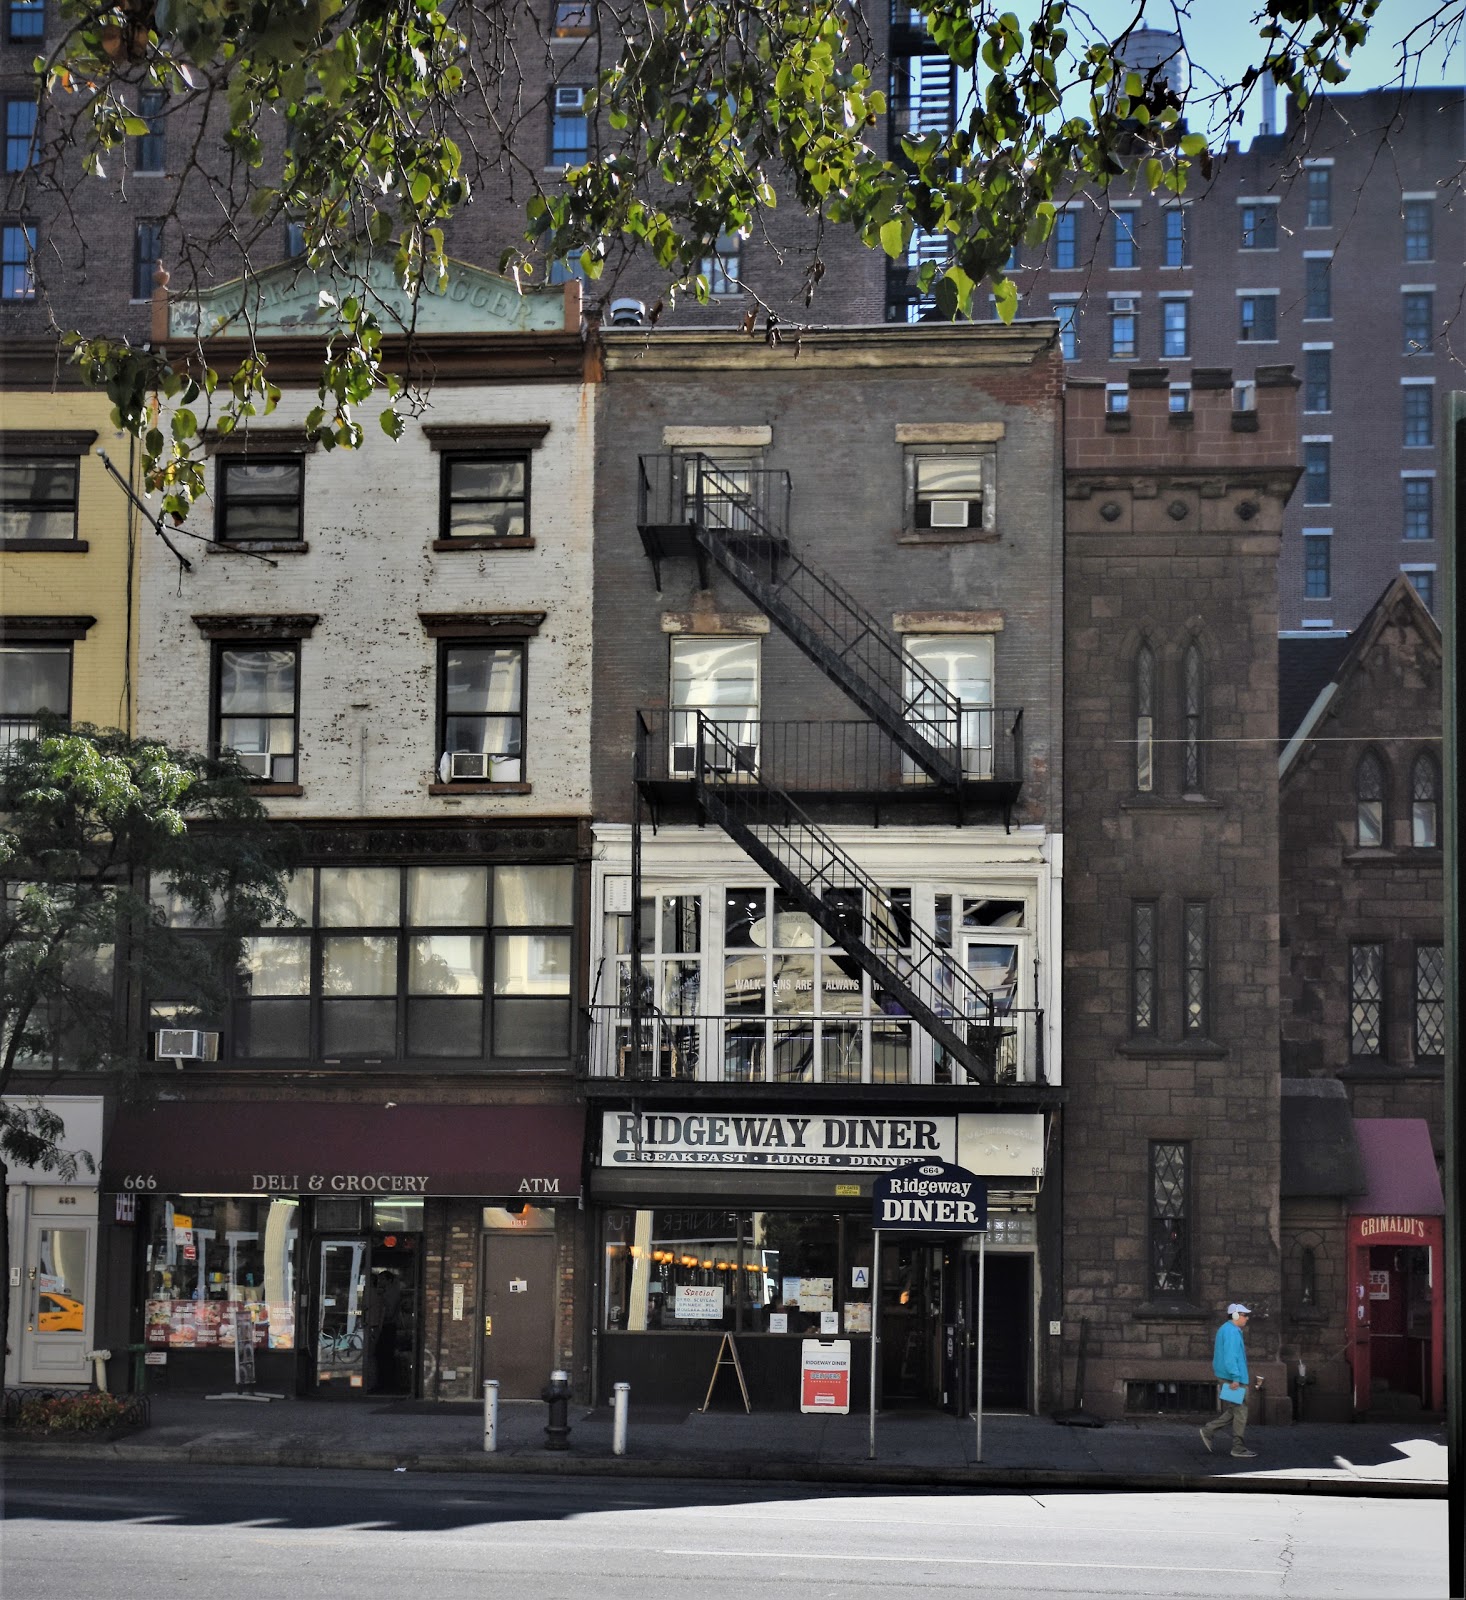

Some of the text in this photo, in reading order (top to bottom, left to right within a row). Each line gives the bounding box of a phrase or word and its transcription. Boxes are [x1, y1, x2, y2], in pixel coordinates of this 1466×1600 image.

[795, 979, 812, 990] ARE
[826, 979, 859, 991] ALWAYS
[616, 1115, 940, 1150] RIDGEWAY DINER
[766, 1154, 831, 1165] LUNCH
[1031, 1167, 1043, 1176] 664
[124, 1175, 560, 1193] 666 DELI & GROCERY ATM
[890, 1178, 971, 1198] Ridgeway
[882, 1199, 979, 1224] DINER
[1361, 1217, 1424, 1237] GRIMALDI'S
[855, 1269, 866, 1282] A
[684, 1288, 715, 1297] Special
